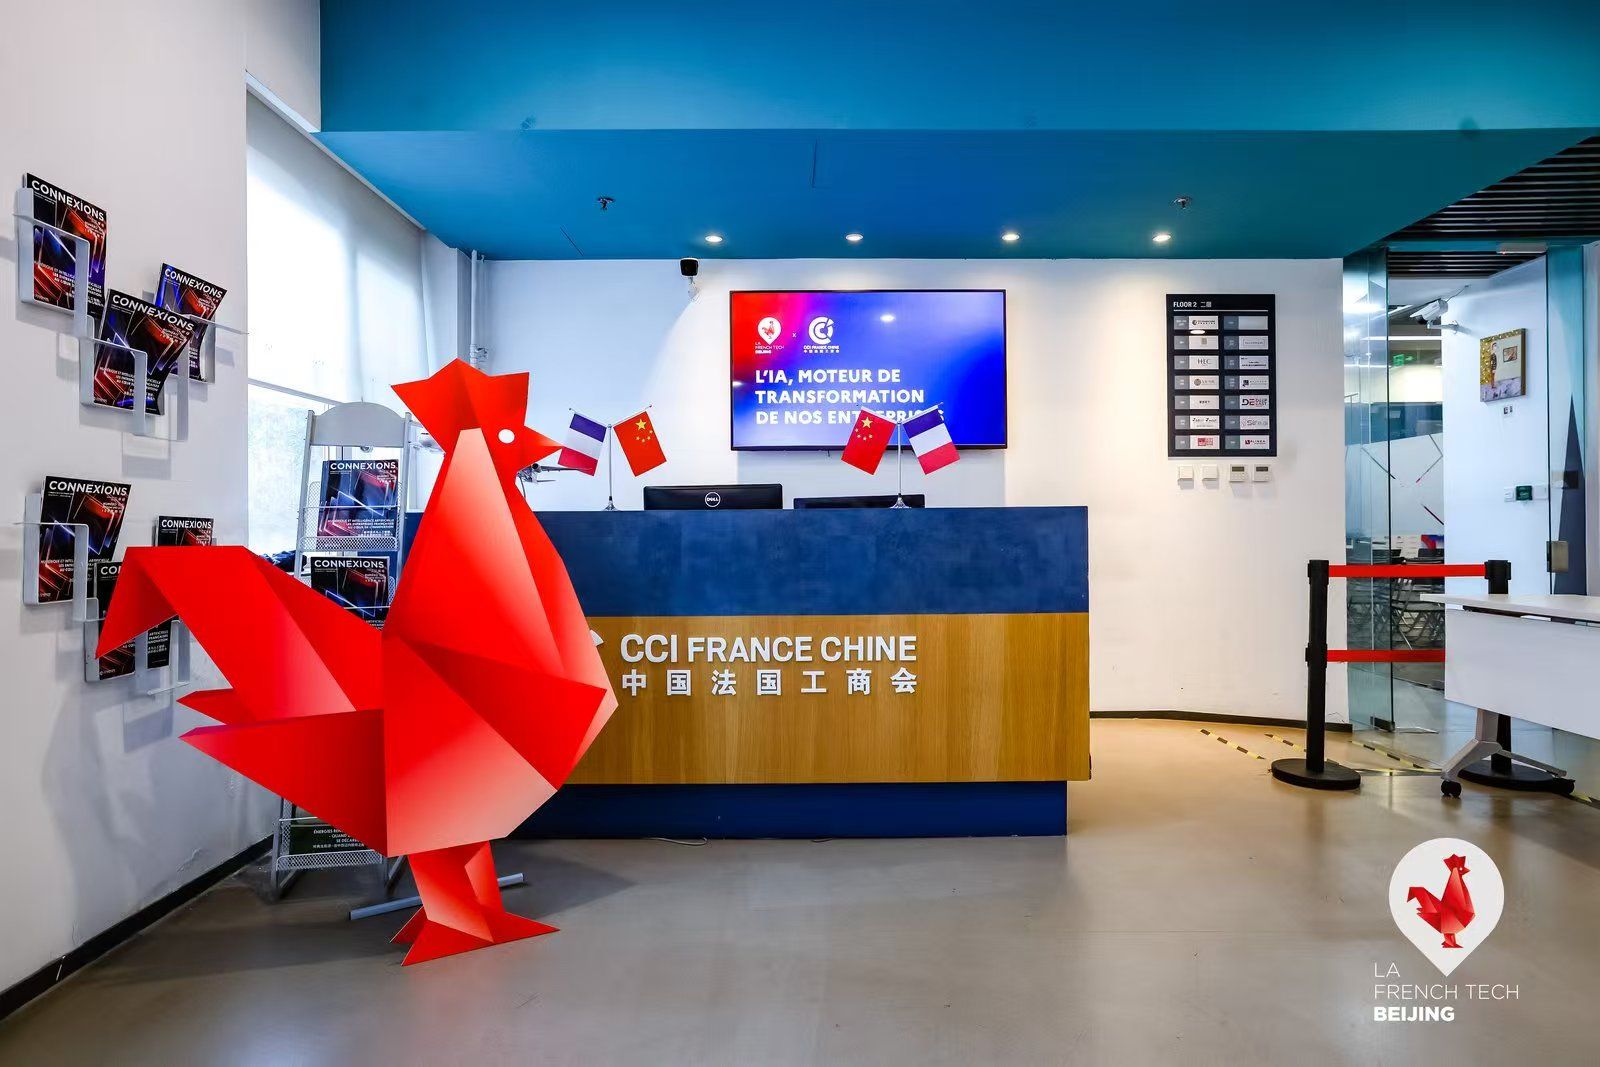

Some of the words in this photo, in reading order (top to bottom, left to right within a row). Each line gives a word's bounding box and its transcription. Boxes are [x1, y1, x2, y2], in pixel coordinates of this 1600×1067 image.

[31, 179, 105, 221] CONNEXIONS
[164, 268, 223, 299] CONNEXIONS
[112, 294, 195, 331] CONNEXIONS
[798, 369, 872, 383] MOTEUR
[878, 369, 901, 383] DE
[755, 389, 924, 404] TRANSFORMATION
[756, 411, 779, 425] DE
[784, 411, 822, 425] NOS
[330, 461, 396, 470] CONNEXIONS
[48, 480, 128, 496] CONNEXIONS
[161, 519, 212, 529] CONNEXIONS
[314, 559, 385, 569] CONNEXIONS
[620, 633, 678, 663] CCI
[688, 636, 813, 662] FRANCE
[820, 636, 917, 662] CHINE
[622, 667, 917, 696] 中国法国工商会
